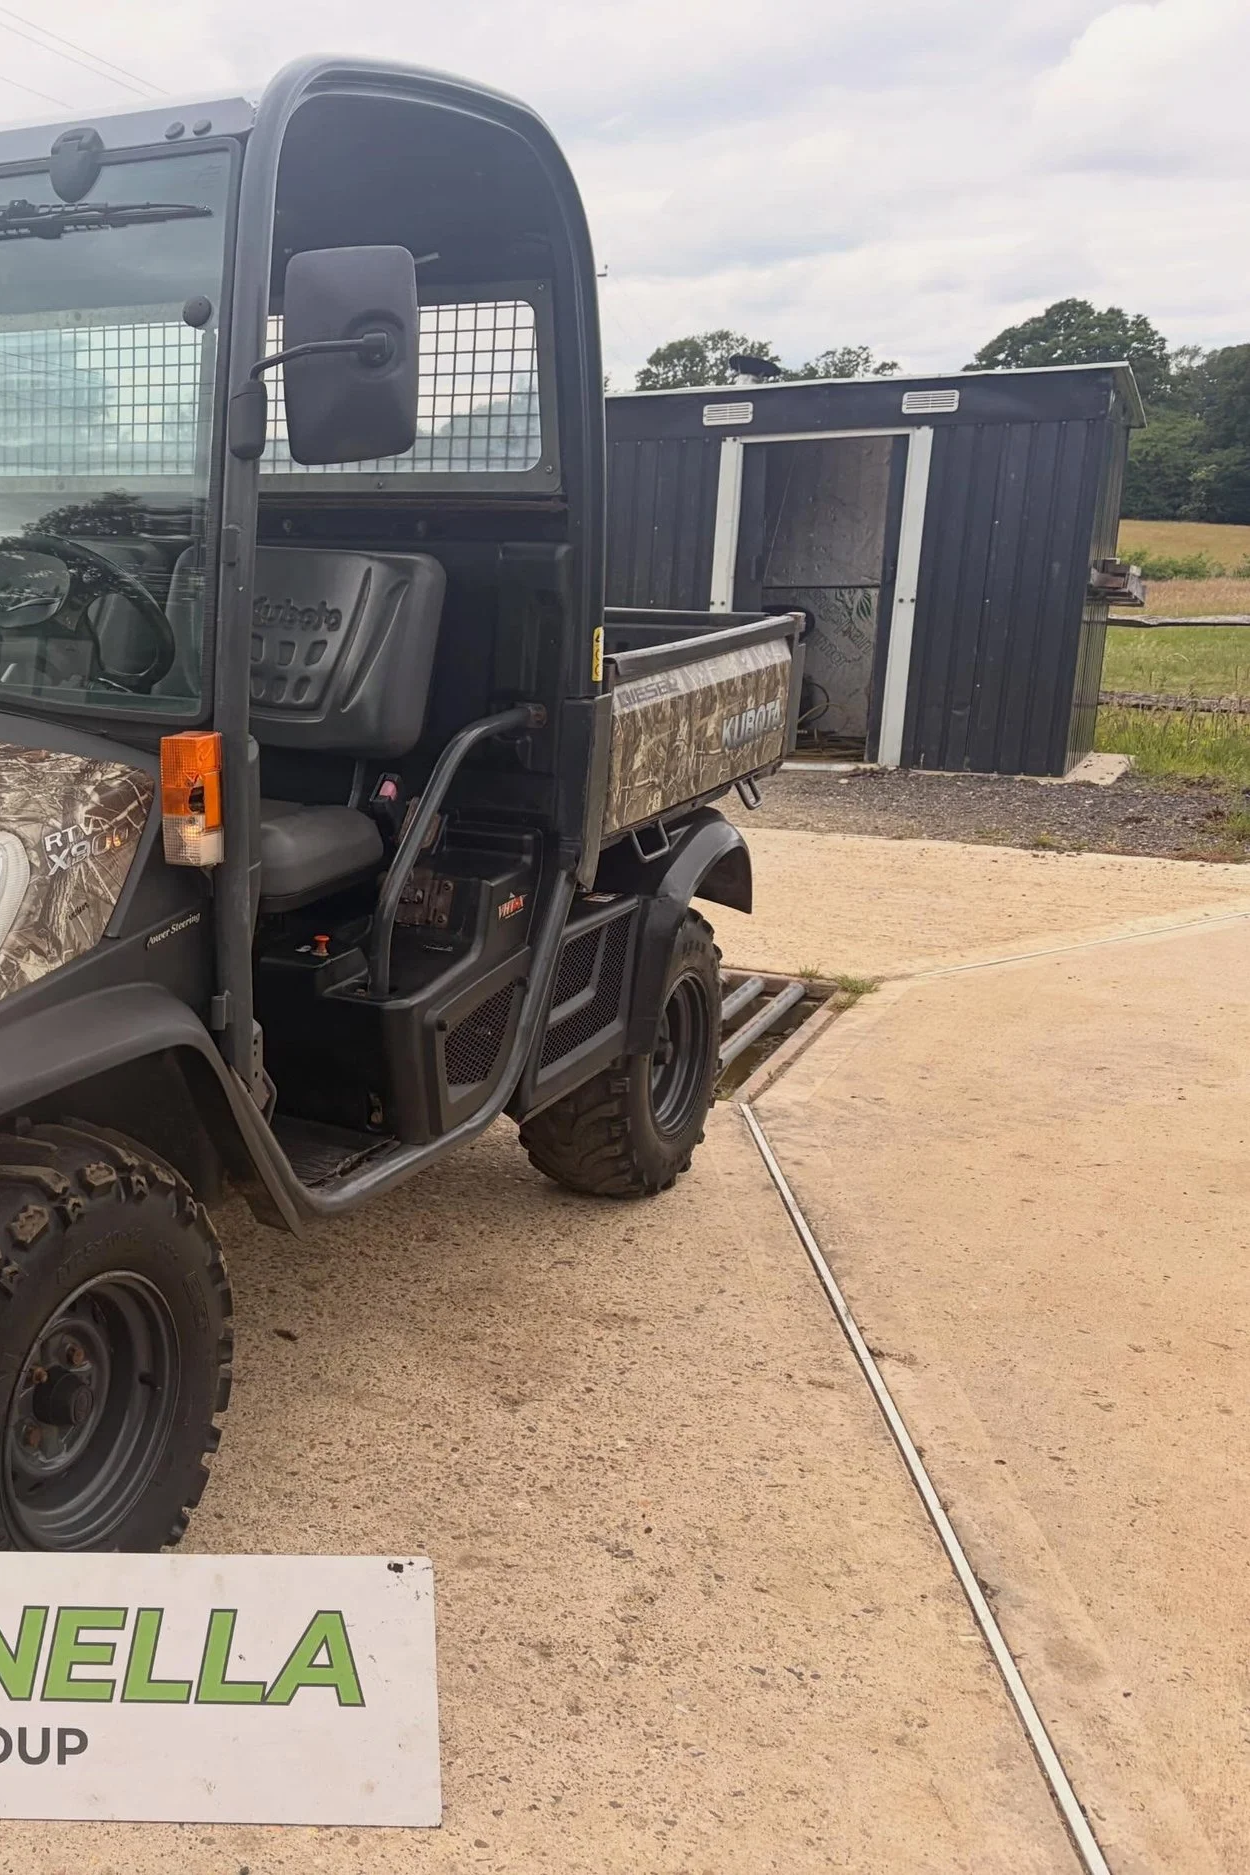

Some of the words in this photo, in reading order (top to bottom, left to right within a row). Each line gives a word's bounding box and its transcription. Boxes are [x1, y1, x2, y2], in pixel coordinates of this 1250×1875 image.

[721, 699, 782, 750] KUBOTA
[44, 817, 94, 852] RTV
[170, 913, 201, 934] Steering
